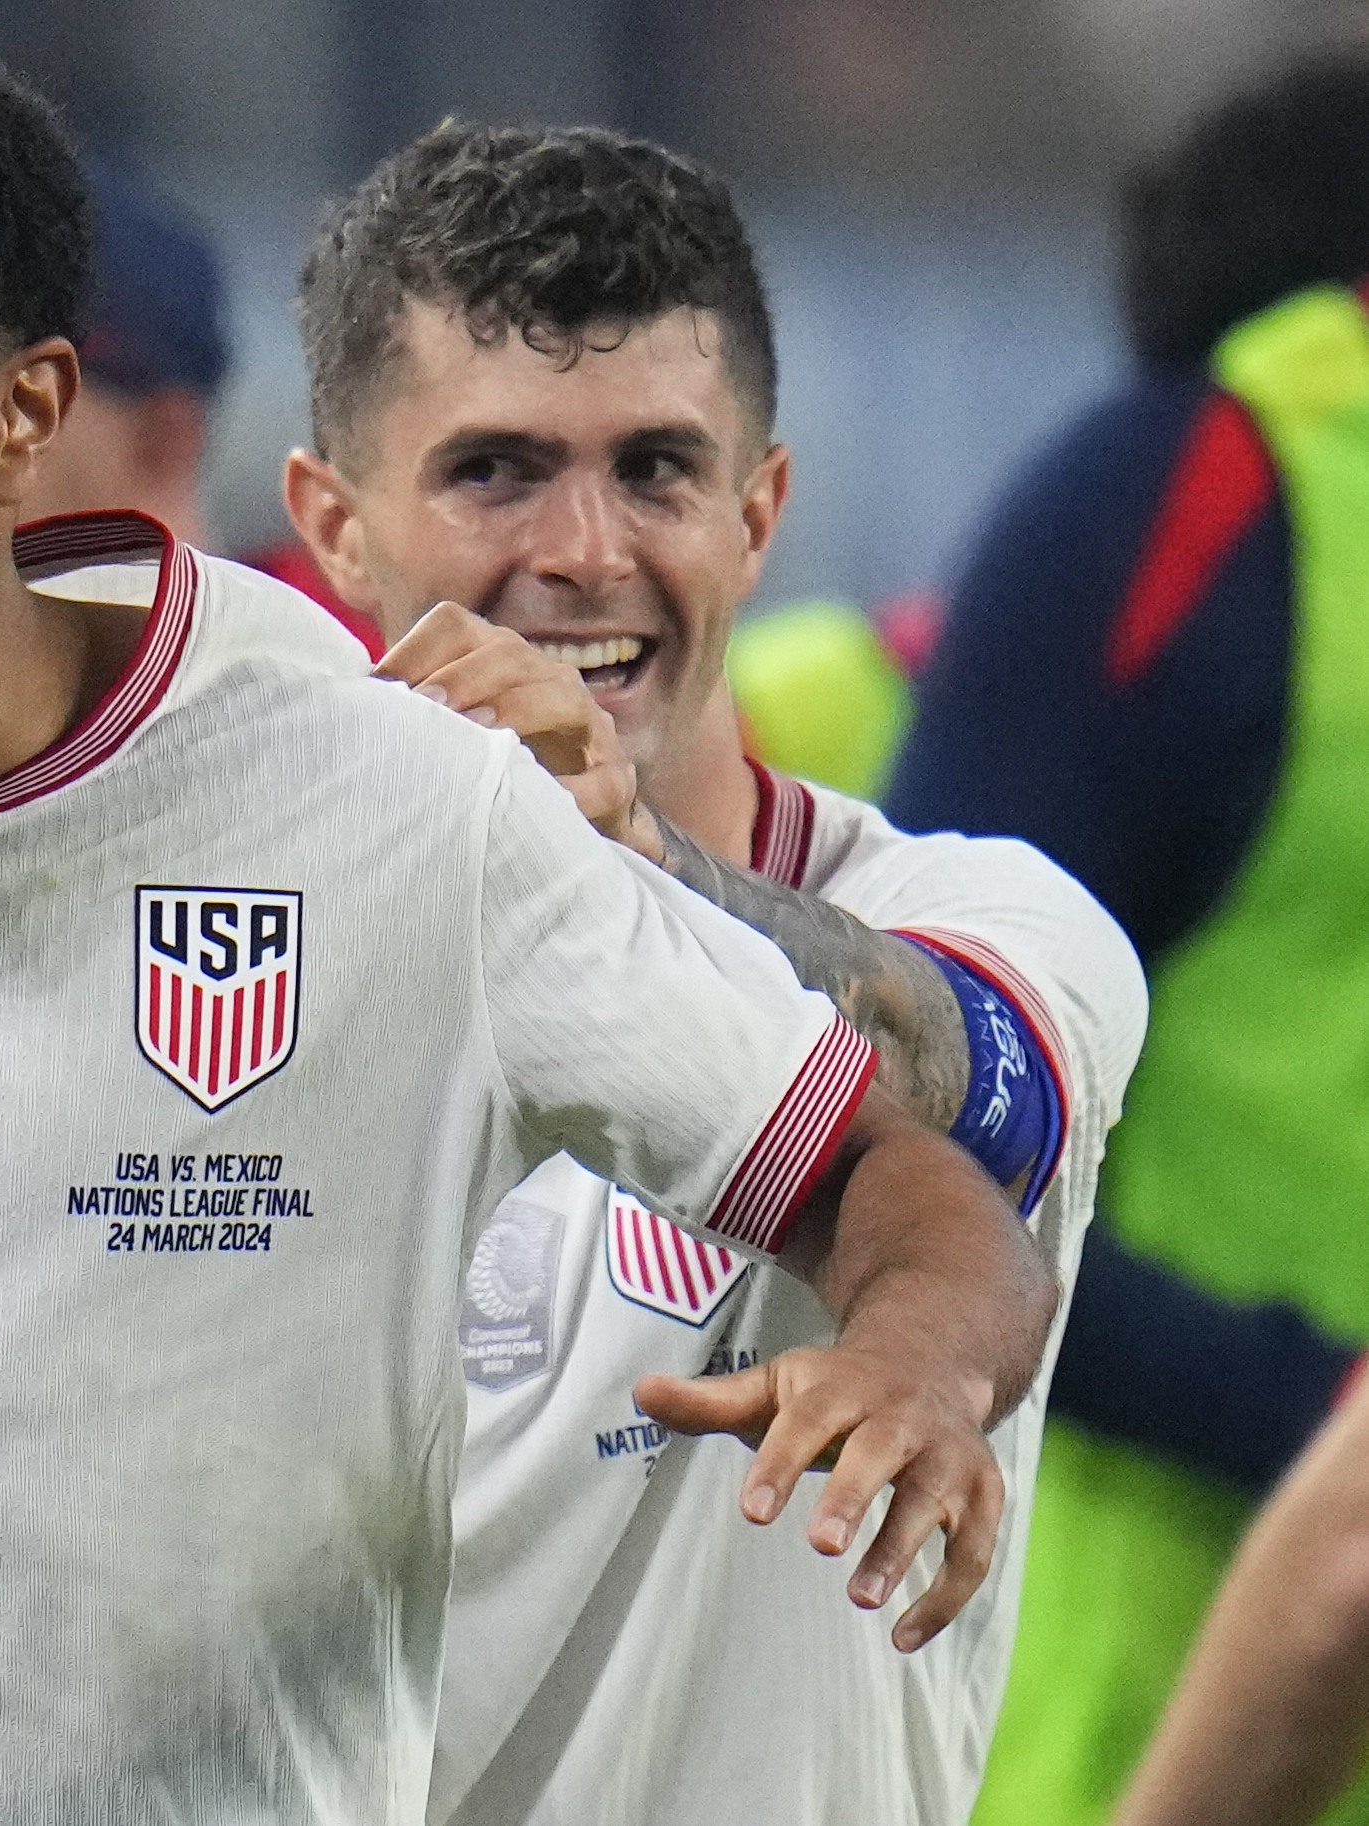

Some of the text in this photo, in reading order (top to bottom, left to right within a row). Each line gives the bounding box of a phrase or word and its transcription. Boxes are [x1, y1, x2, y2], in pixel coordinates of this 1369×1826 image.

[149, 900, 289, 981] USA
[116, 1153, 283, 1182] USA VS. MEXICO
[67, 1187, 314, 1217] NATIONS LEAGUE FINAL
[107, 1222, 273, 1252] 24 MARCH 2024
